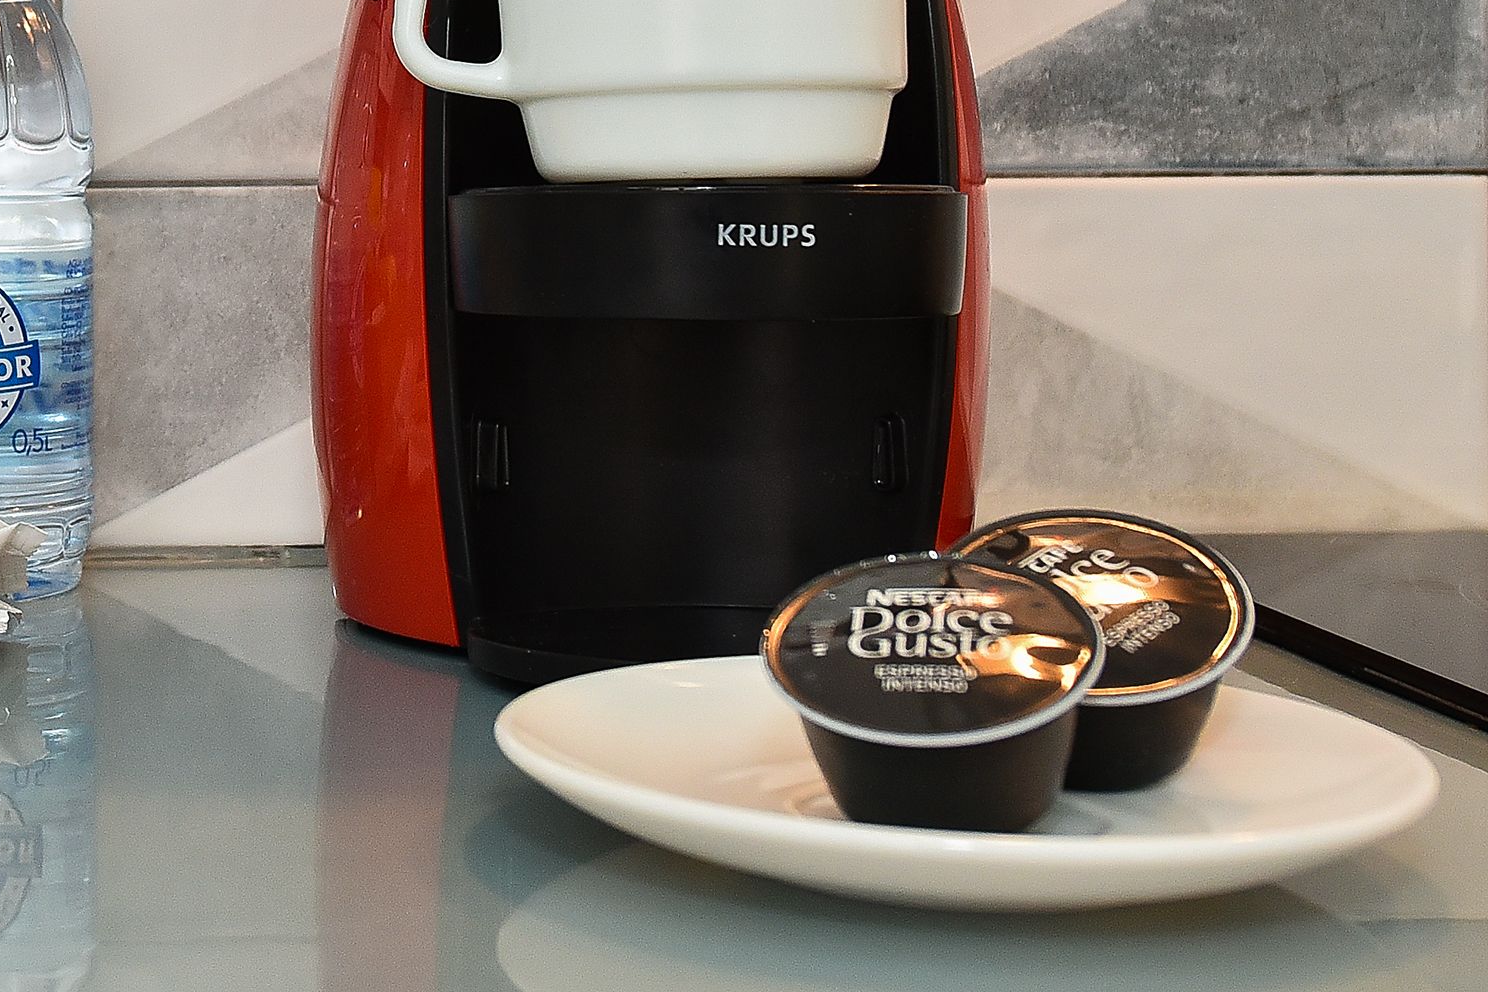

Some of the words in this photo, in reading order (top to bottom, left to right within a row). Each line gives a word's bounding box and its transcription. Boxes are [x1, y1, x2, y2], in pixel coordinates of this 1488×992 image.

[717, 223, 816, 248] KRUPS
[851, 606, 1014, 635] Dolce
[847, 630, 1014, 659] Gusto
